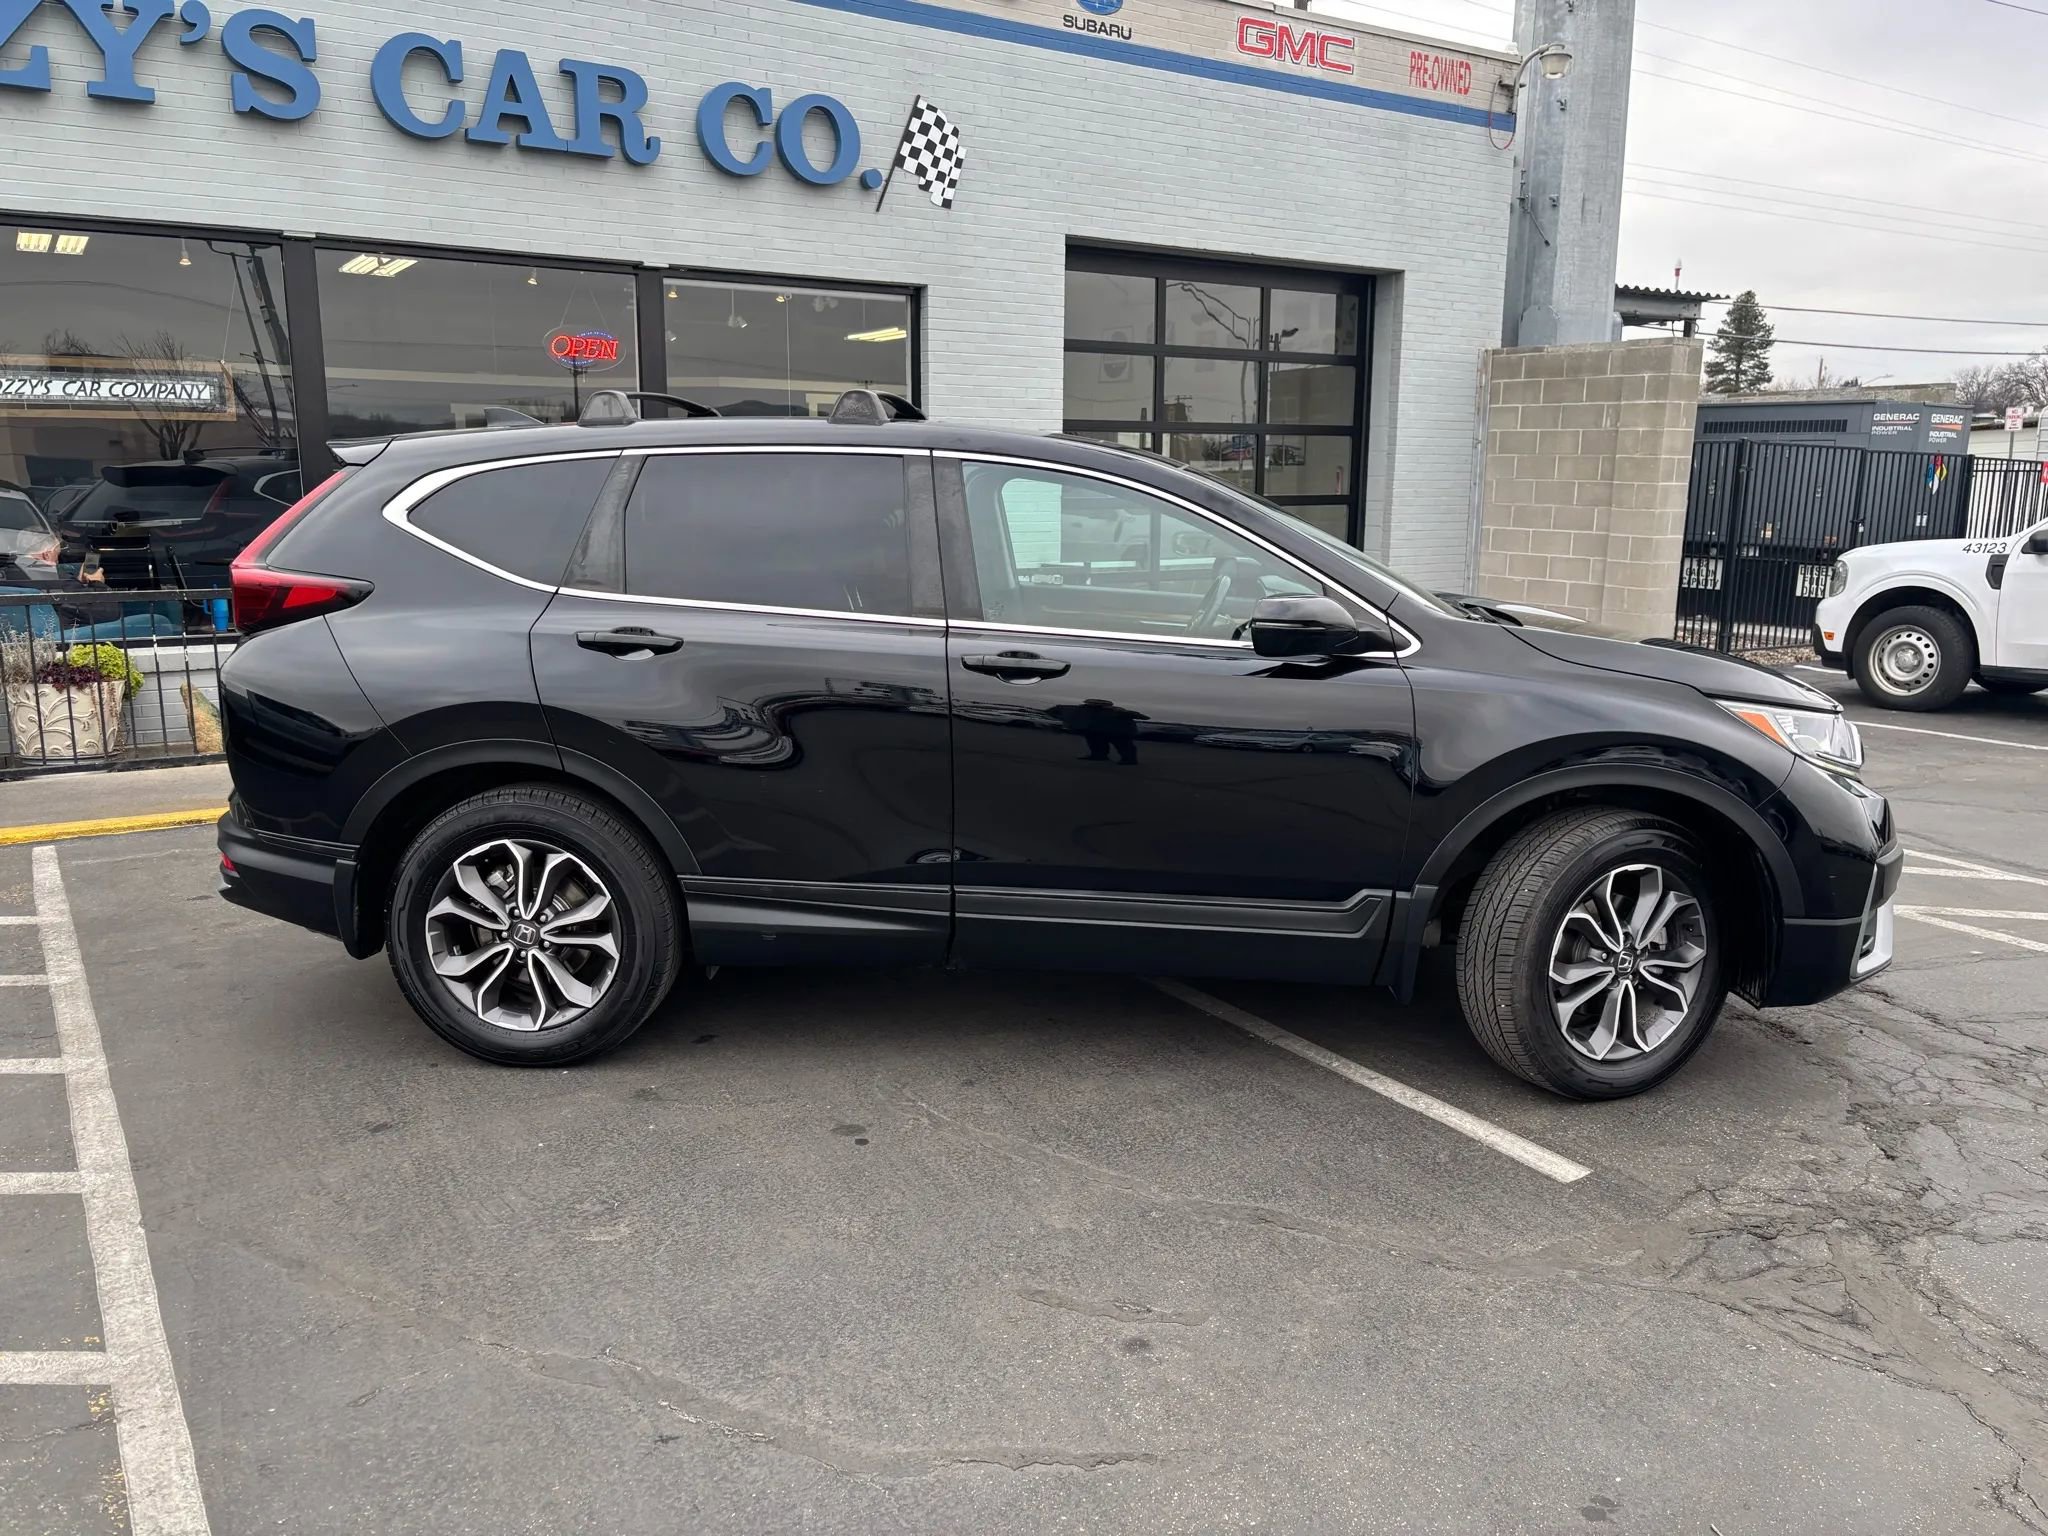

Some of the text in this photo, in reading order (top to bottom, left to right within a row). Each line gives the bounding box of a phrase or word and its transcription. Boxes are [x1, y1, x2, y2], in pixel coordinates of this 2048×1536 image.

[1062, 14, 1133, 41] SUBARU
[1236, 15, 1355, 75] GMC
[1409, 50, 1472, 96] PRE-OWNED
[371, 31, 660, 166] CAR
[696, 81, 883, 190] CO.
[551, 335, 619, 360] OPEN
[0, 378, 208, 400] ZZY'S CAR COMPANY
[1873, 413, 1920, 421] GENERAC
[1931, 414, 1964, 424] GENERAC
[1962, 542, 2007, 554] 43123
